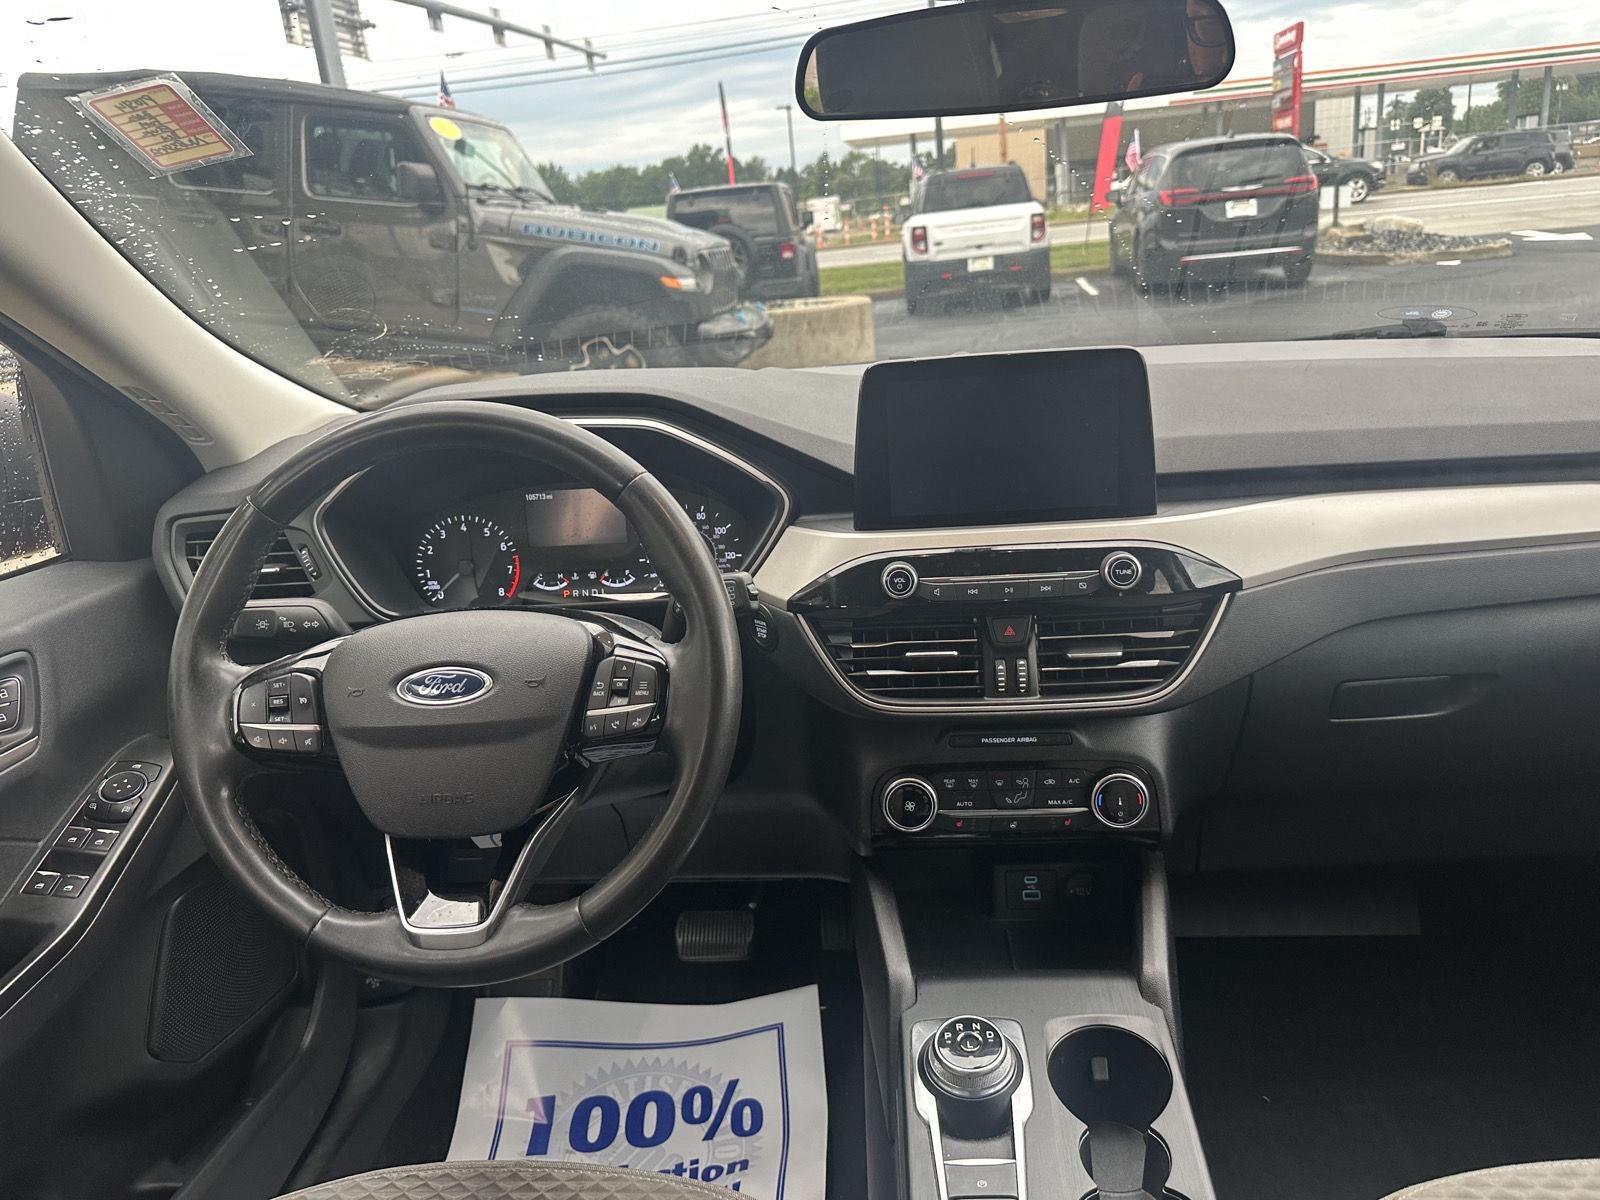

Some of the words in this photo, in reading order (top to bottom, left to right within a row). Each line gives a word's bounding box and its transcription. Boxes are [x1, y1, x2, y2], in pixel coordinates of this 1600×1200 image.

[522, 223, 661, 252] RUBICON
[696, 512, 706, 520] 80
[460, 522, 467, 532] 4
[483, 527, 490, 537] 5
[714, 526, 727, 535] 100
[440, 529, 446, 539] 3
[427, 545, 434, 555] 2
[500, 542, 507, 551] 6
[724, 551, 736, 559] 120
[426, 569, 431, 578] 1
[507, 565, 513, 575] 7
[437, 590, 444, 600] 0
[498, 587, 505, 596] 8
[563, 590, 570, 598] P
[417, 674, 468, 696] Ford
[944, 1032, 952, 1040] P
[955, 1023, 964, 1031] R
[972, 1022, 981, 1030] N
[986, 1030, 995, 1038] D
[966, 1040, 974, 1049] L
[526, 1078, 764, 1157] 100%
